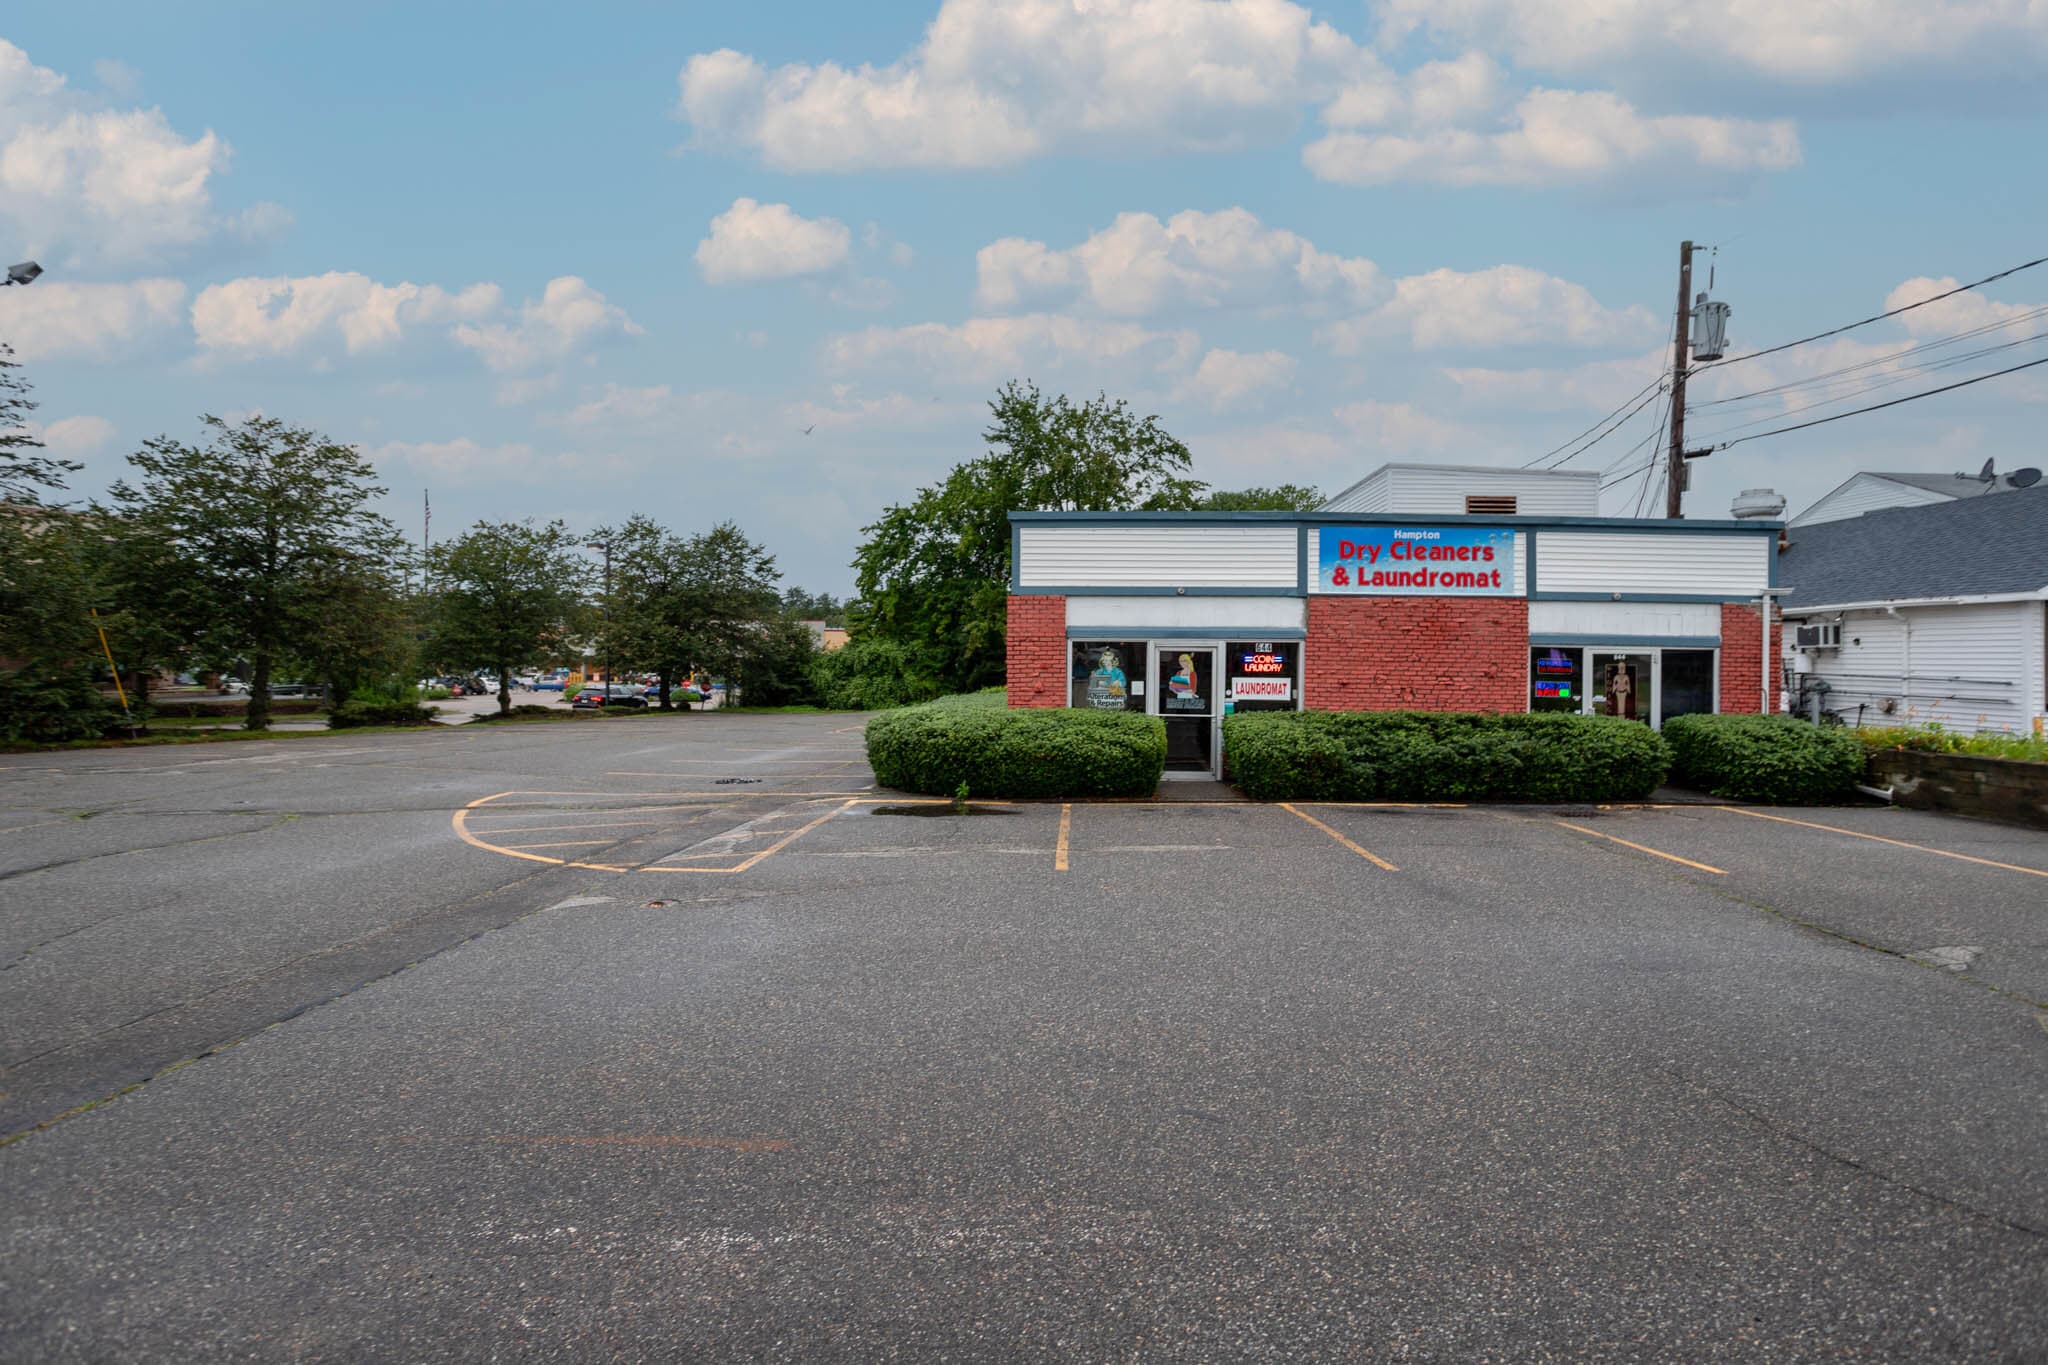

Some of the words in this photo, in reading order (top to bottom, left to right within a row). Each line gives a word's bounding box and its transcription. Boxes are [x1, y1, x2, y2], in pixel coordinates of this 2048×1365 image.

[1393, 529, 1441, 541] Hampton
[1338, 540, 1382, 564] Dry
[1389, 541, 1494, 562] Cleaners
[1332, 566, 1350, 586] &
[1357, 566, 1502, 588] Laundromat
[1252, 655, 1275, 663] COIN
[1244, 663, 1283, 672] LAUNDRY
[1235, 682, 1287, 695] LAUNDROMAT
[1097, 699, 1123, 707] Repairs
